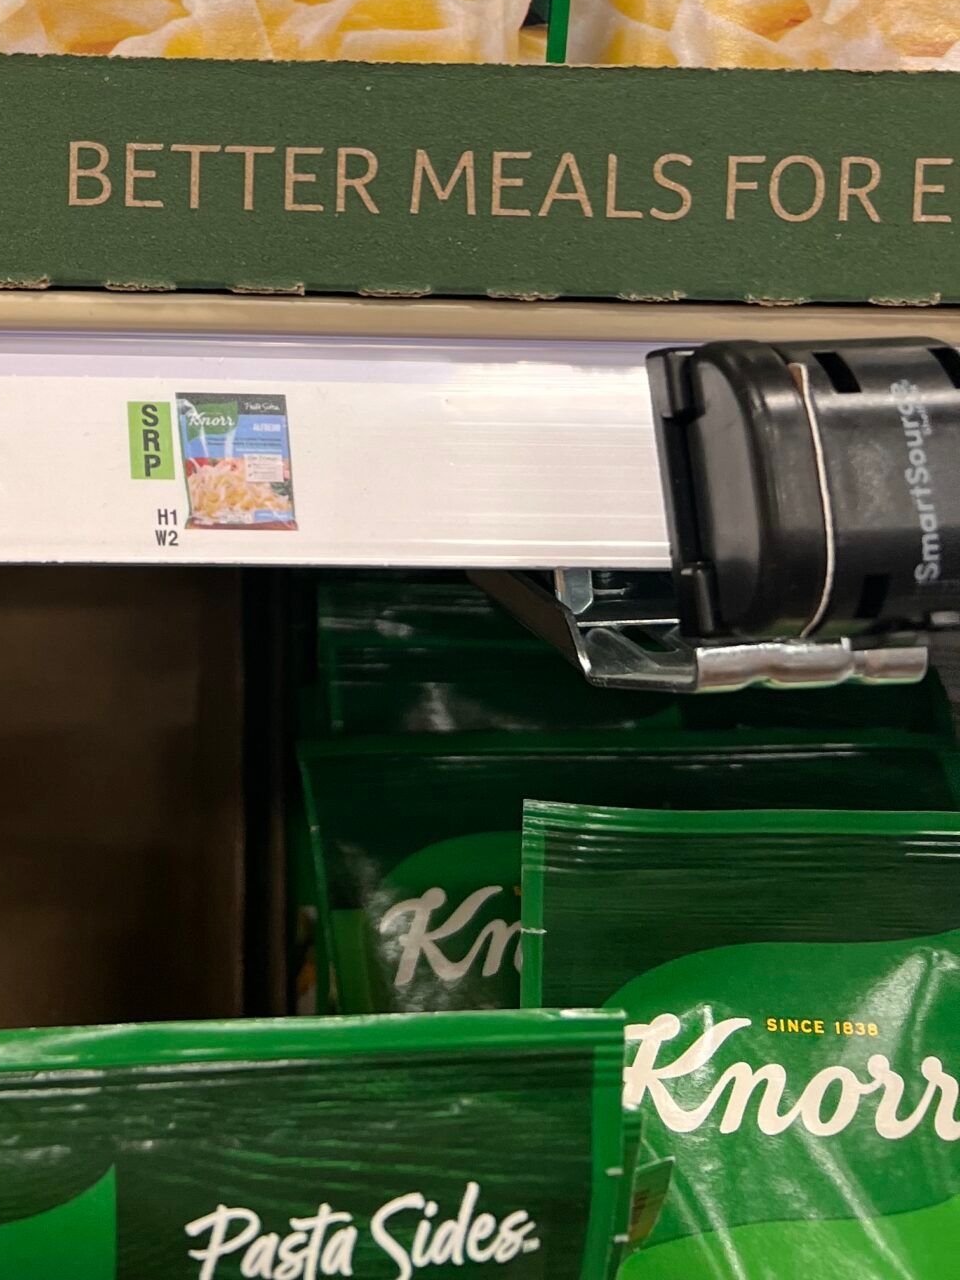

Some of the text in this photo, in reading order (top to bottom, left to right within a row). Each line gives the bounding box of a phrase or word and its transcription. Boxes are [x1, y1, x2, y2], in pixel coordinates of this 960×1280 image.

[68, 139, 379, 216] BETTER
[409, 149, 693, 222] MEALS
[727, 154, 882, 224] FOR
[188, 411, 236, 427] Knorr
[157, 508, 178, 526] H1
[155, 529, 179, 547] W2
[766, 1018, 879, 1036] SINCE 1838
[623, 1013, 960, 1141] Knorr
[184, 1181, 537, 1280] Pasta Sides
